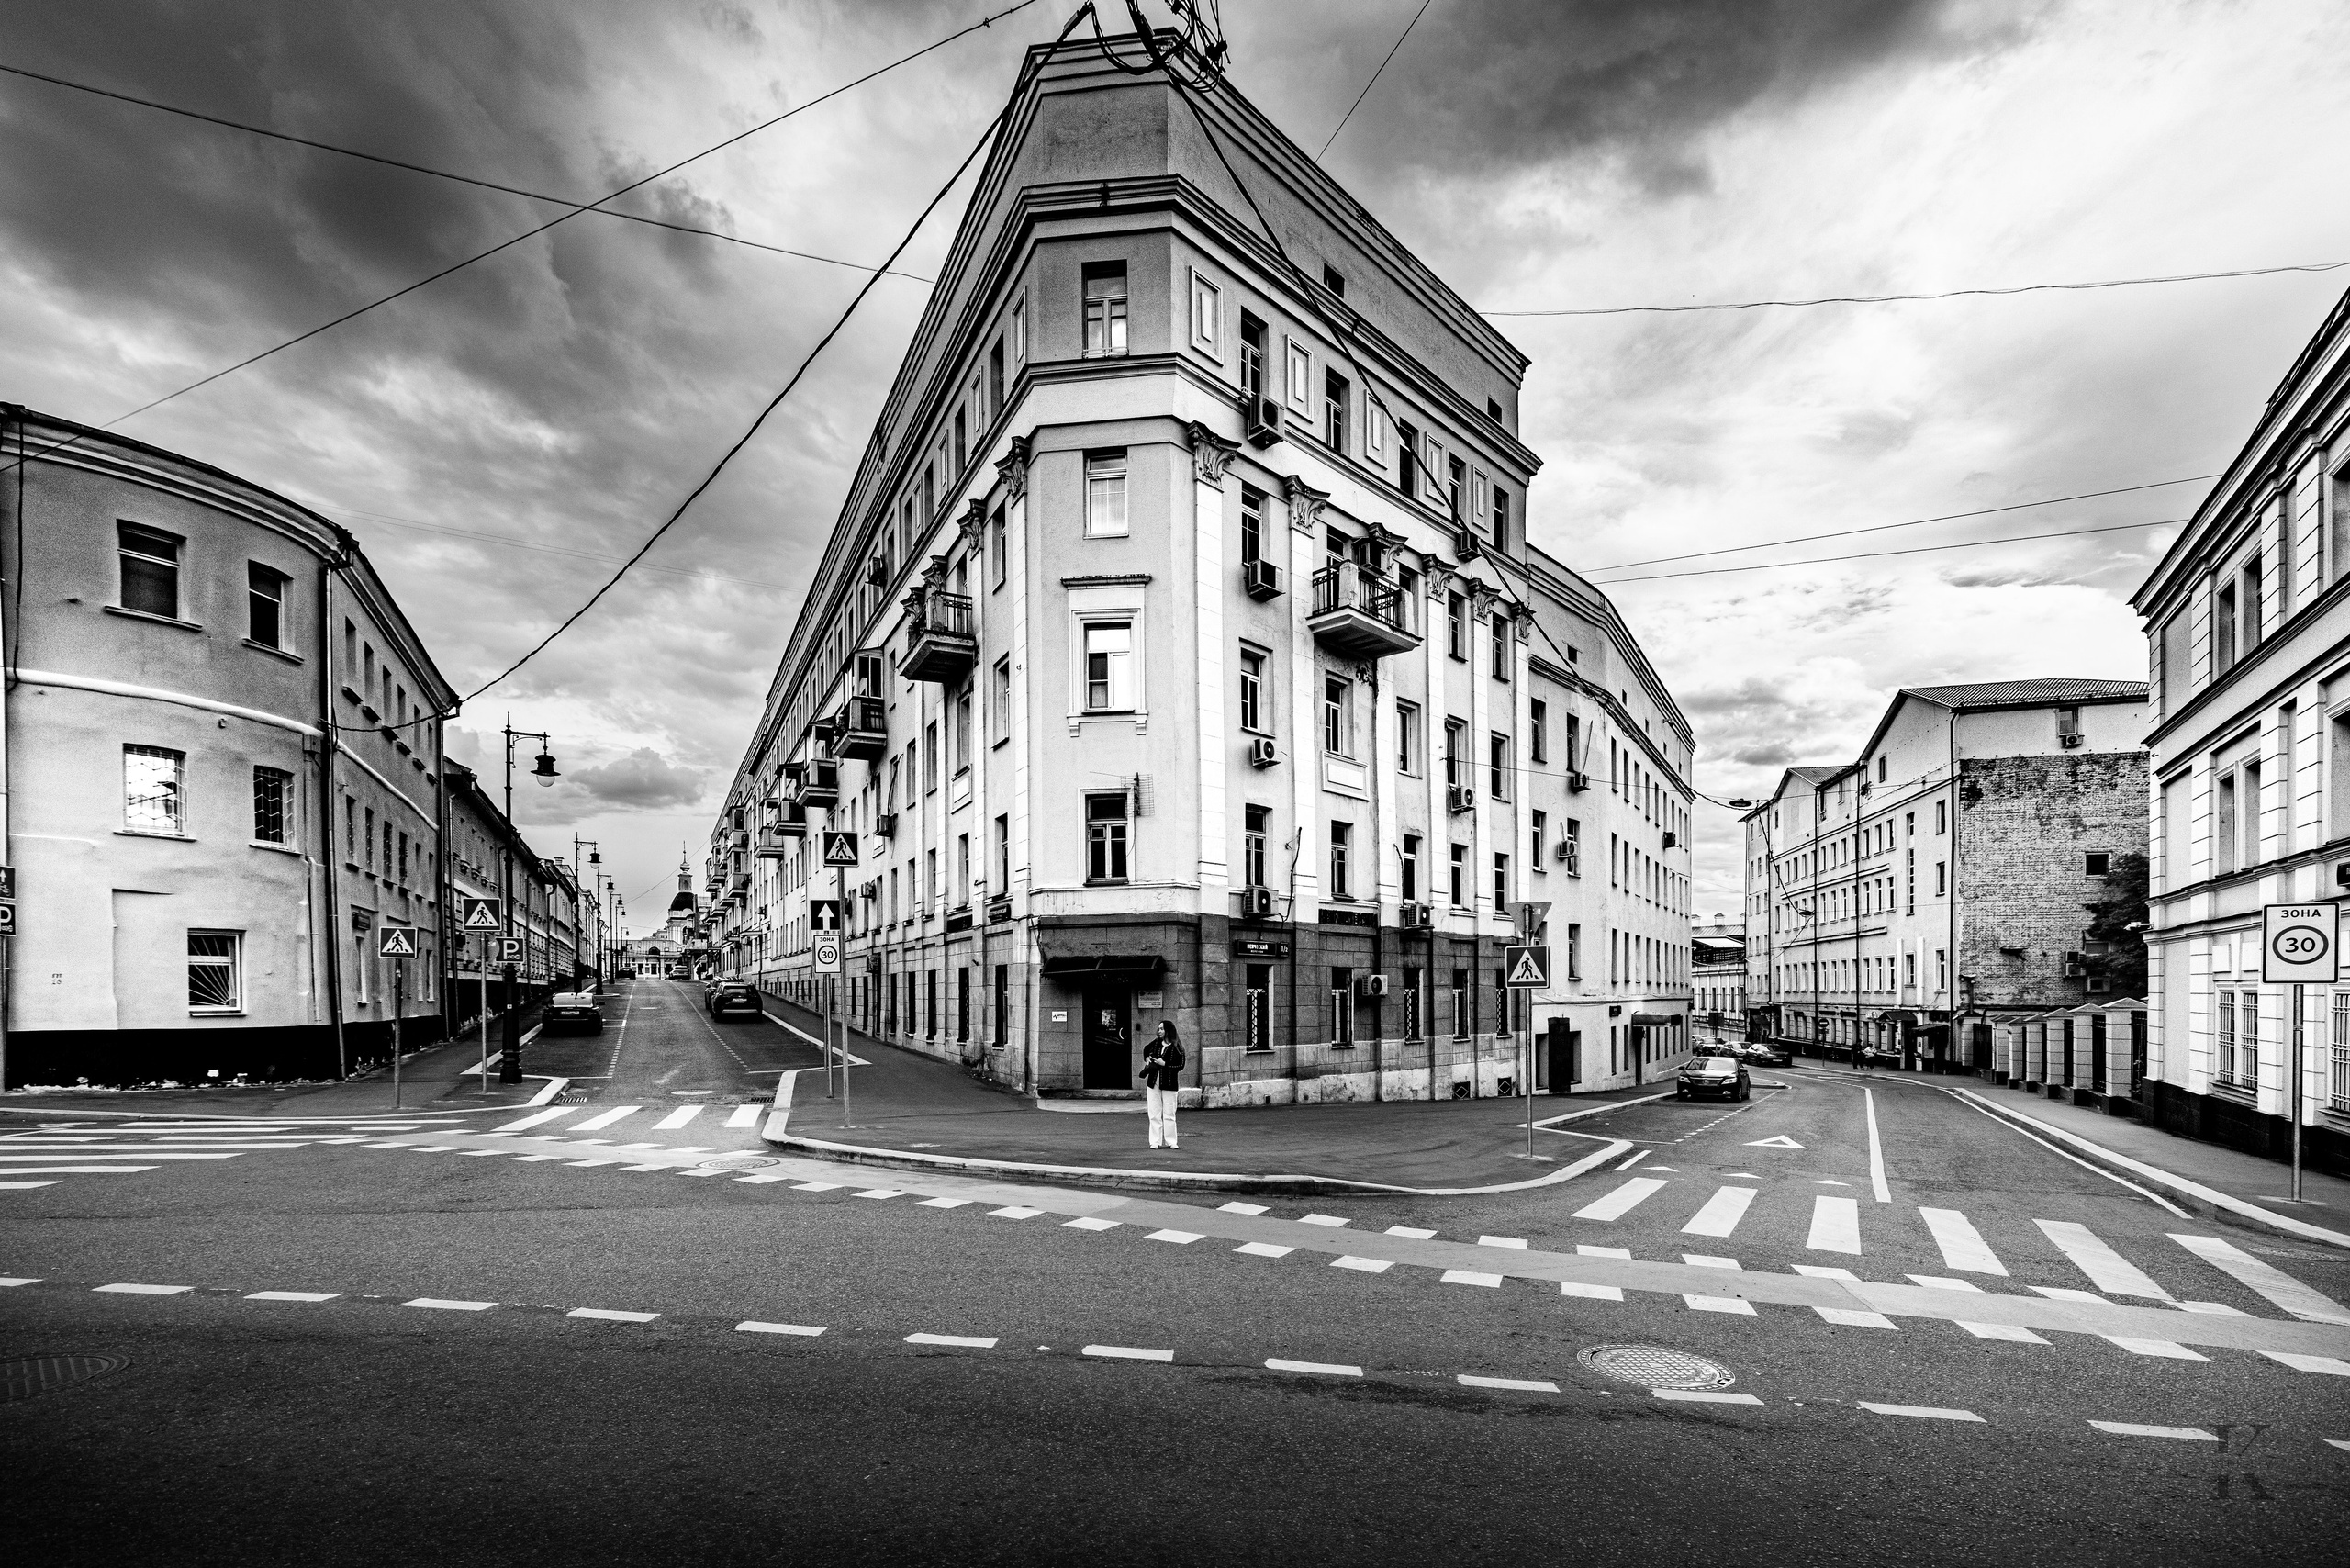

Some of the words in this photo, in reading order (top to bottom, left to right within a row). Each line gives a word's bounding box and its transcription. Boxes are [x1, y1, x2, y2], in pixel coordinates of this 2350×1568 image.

[2281, 909, 2321, 918] ЗОНА
[503, 940, 520, 959] P
[2285, 937, 2316, 953] 30
[822, 951, 834, 959] 30
